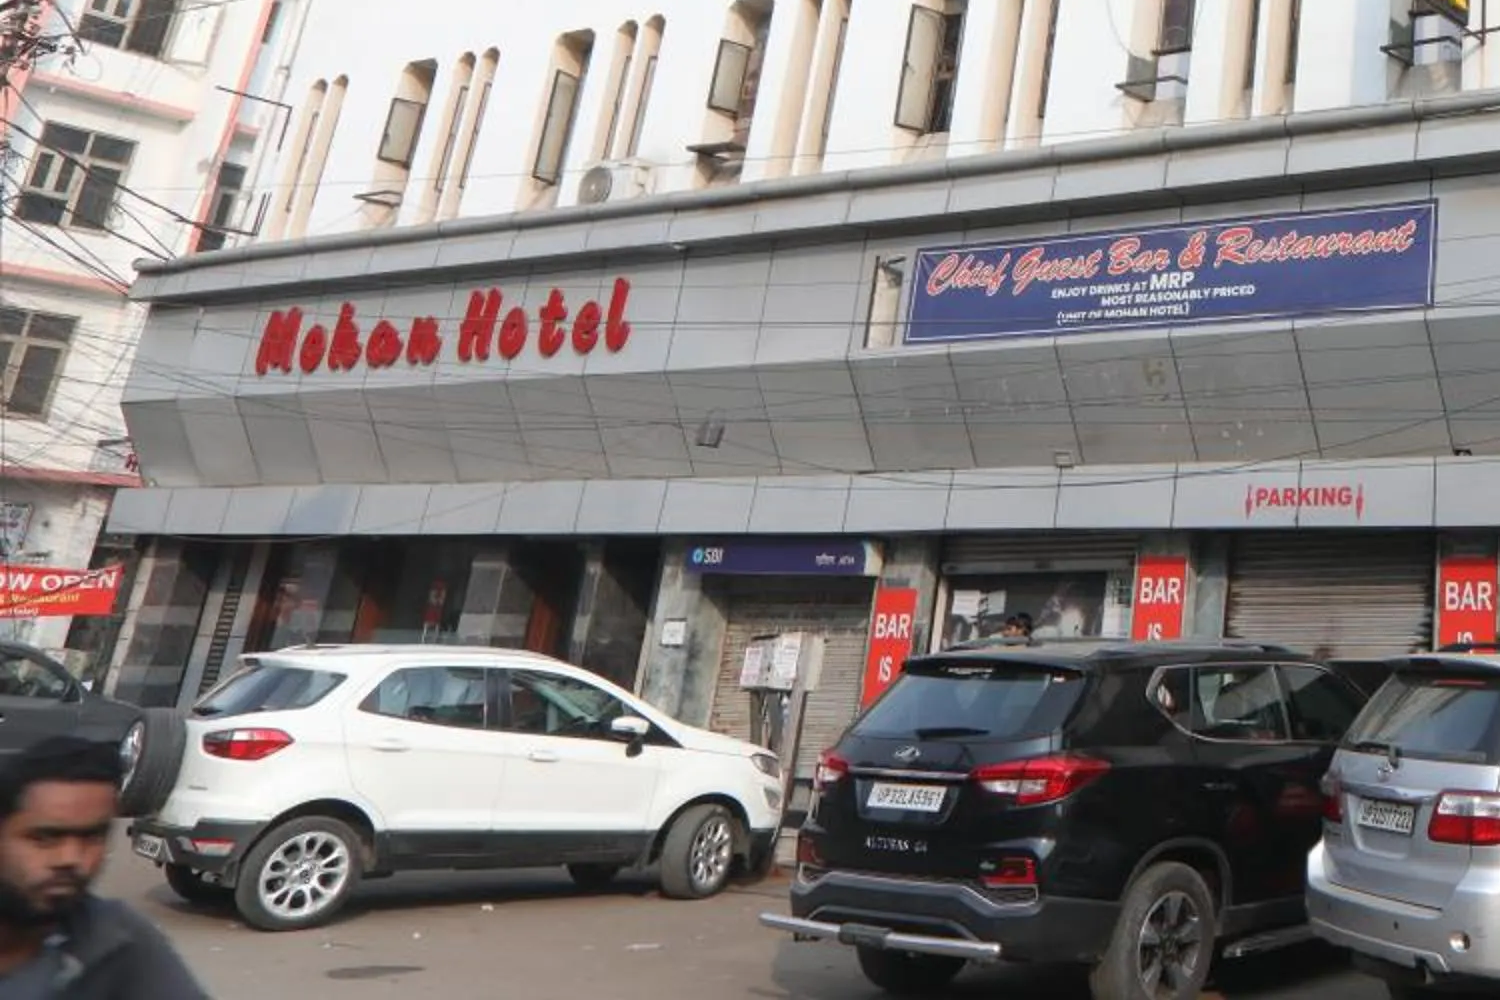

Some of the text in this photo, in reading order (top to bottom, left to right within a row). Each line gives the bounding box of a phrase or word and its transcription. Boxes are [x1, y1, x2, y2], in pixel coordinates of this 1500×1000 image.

[927, 219, 1417, 297] Chief Guest Bar & Restaurant
[1051, 272, 1195, 299] ENJOY DRINKS AT MRP
[1101, 285, 1256, 306] MOST REASONABLY PRICED
[256, 277, 631, 376] Mohan Hotel
[1256, 487, 1353, 507] PARKING
[704, 548, 723, 564] SBI
[0, 571, 118, 591] W OPEN
[1140, 577, 1181, 604] BAR
[1445, 581, 1493, 611] BAR
[874, 613, 911, 639] BAR
[879, 656, 892, 682] IS
